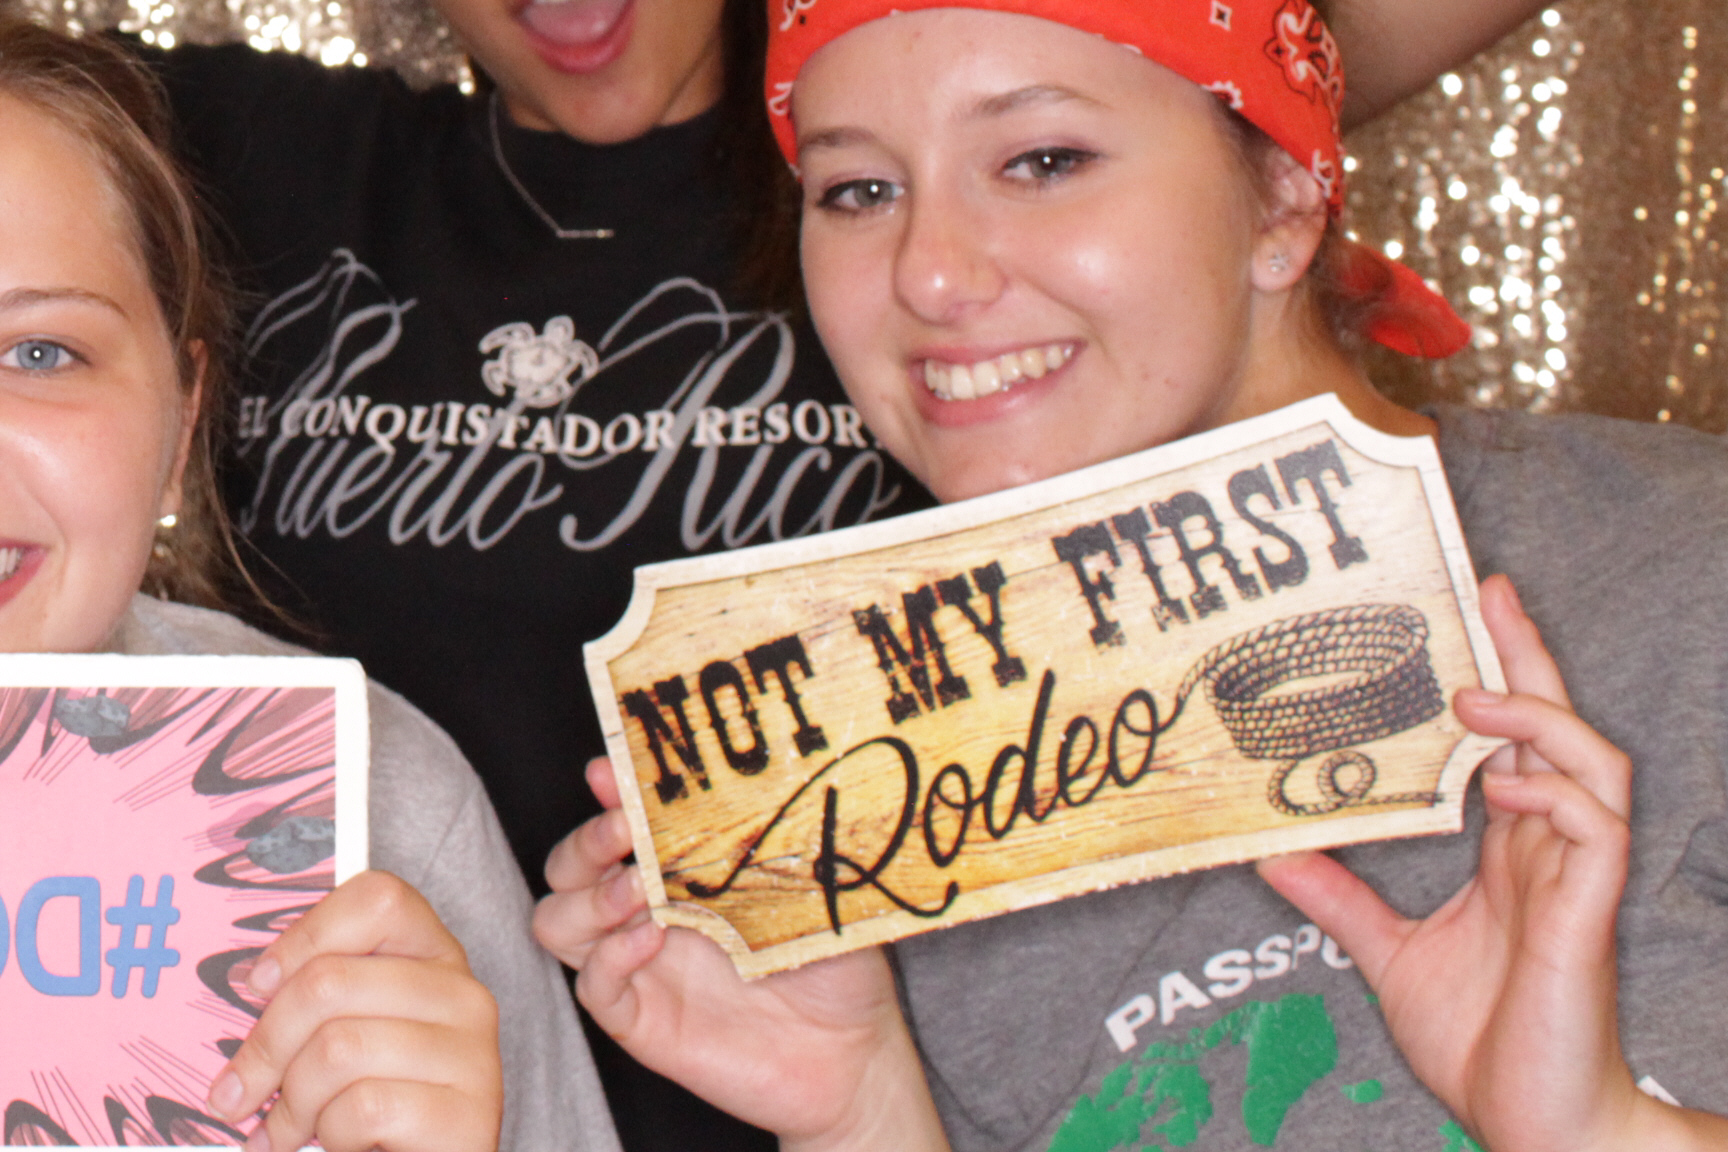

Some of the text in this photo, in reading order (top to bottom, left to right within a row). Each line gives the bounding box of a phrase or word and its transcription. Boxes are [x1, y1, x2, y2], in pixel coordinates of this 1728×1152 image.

[280, 395, 675, 457] CONQUISTADOR
[692, 399, 884, 448] RESOR
[558, 276, 901, 550] Rico
[622, 439, 1370, 805] NOT MY FIRST
[686, 668, 1184, 936] Rodeo
